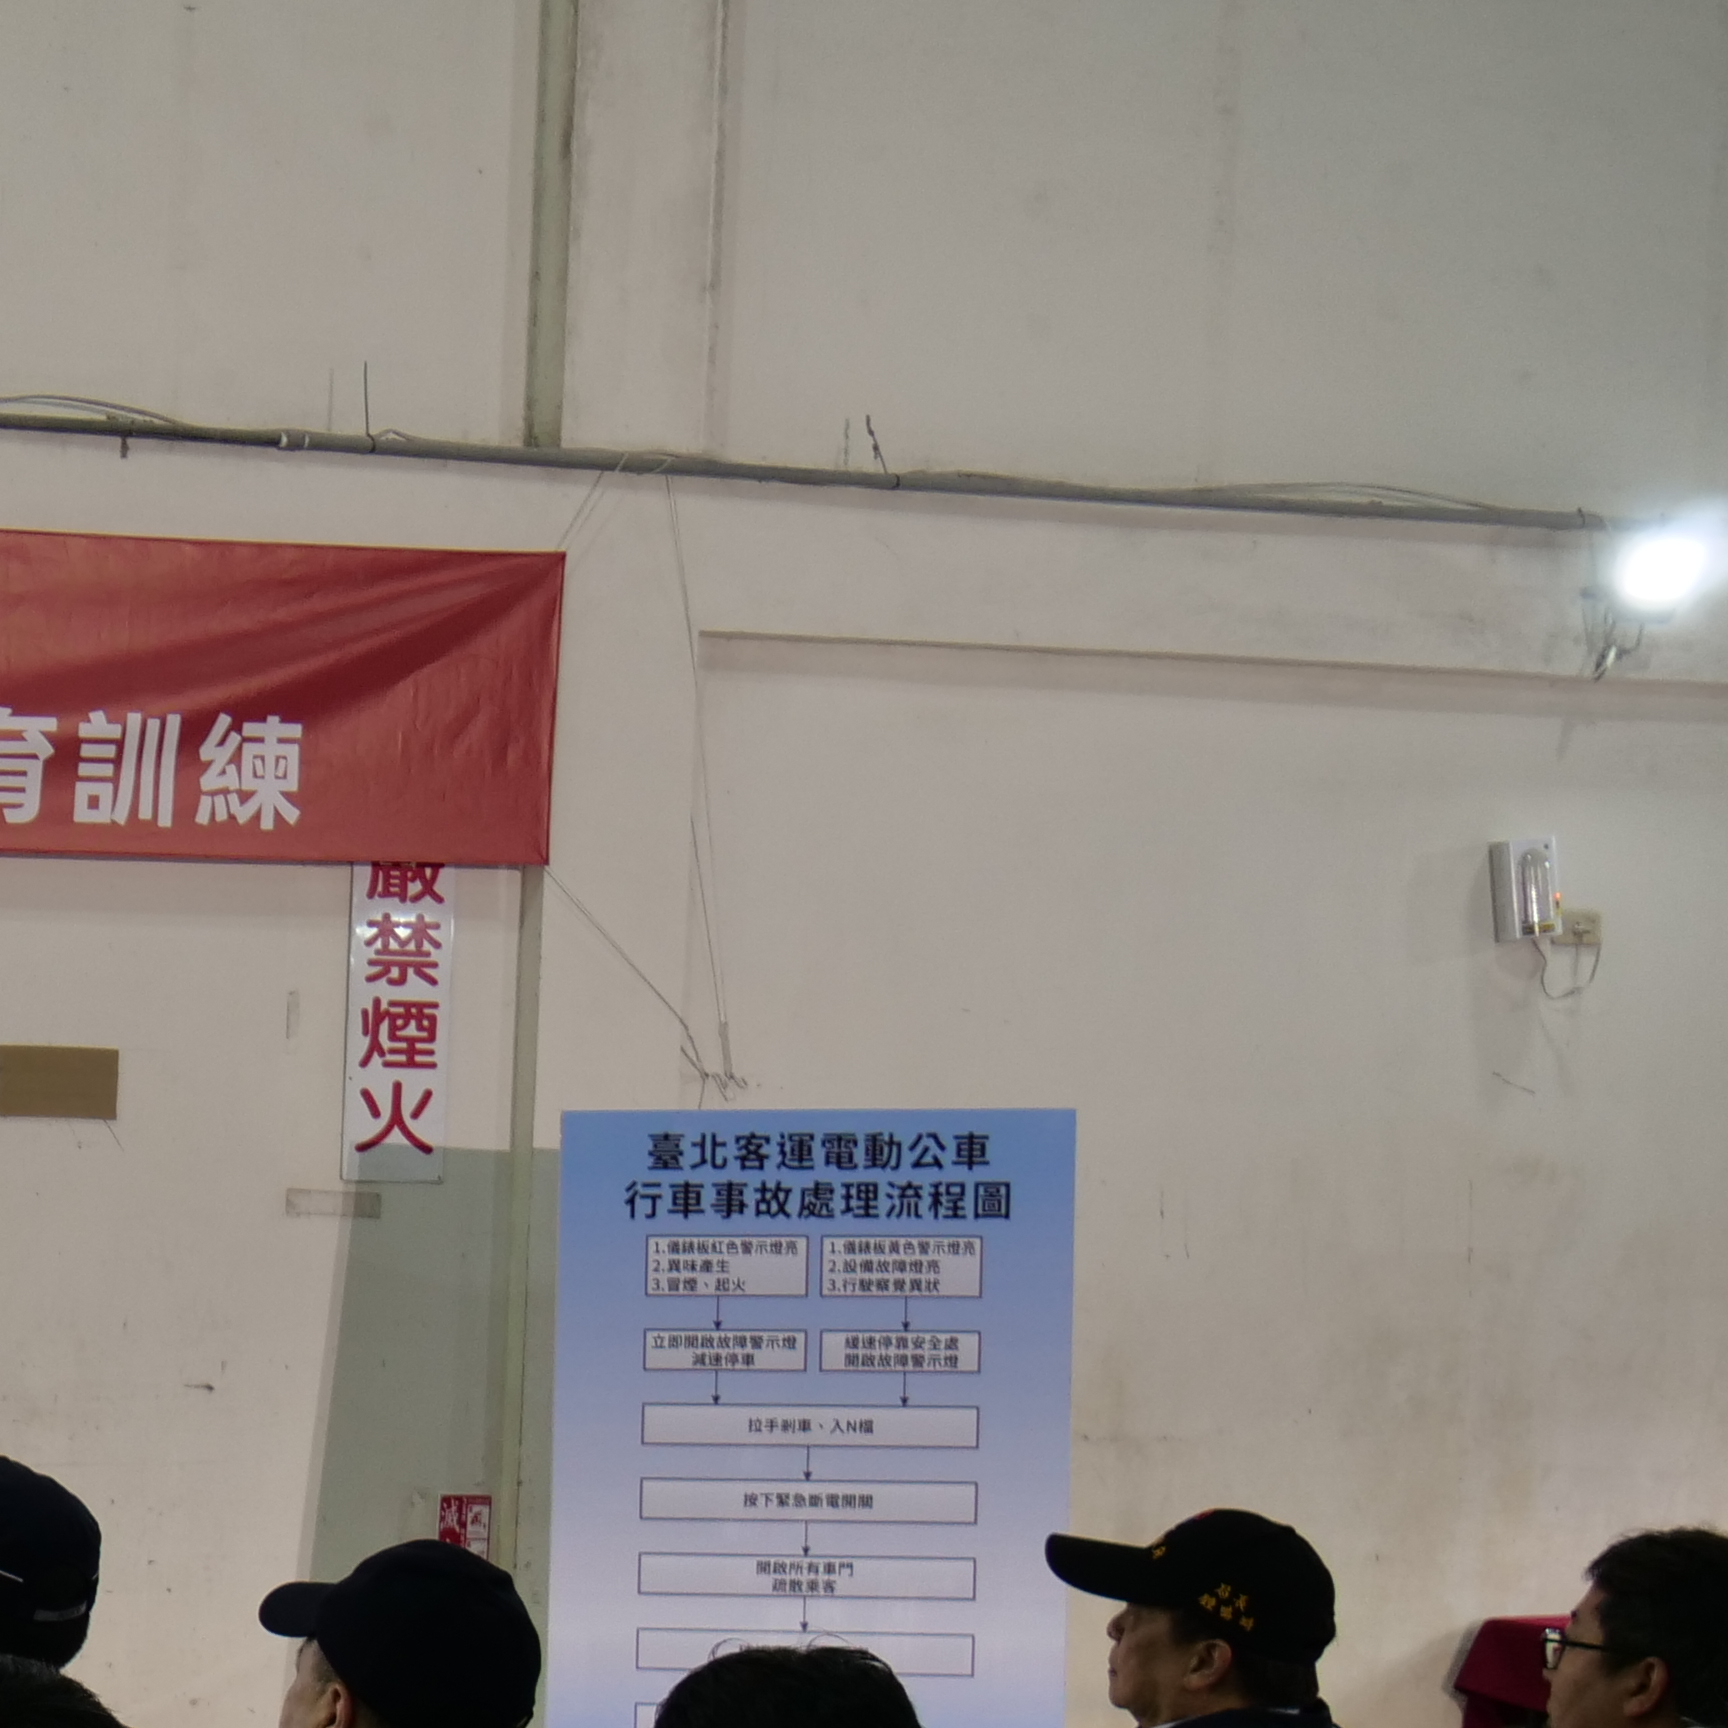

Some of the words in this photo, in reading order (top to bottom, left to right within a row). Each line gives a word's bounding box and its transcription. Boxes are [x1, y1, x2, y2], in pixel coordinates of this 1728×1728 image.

[647, 1130, 991, 1171] 臺北客運電動公車
[624, 1179, 1012, 1221] 行車事故處理流程圖
